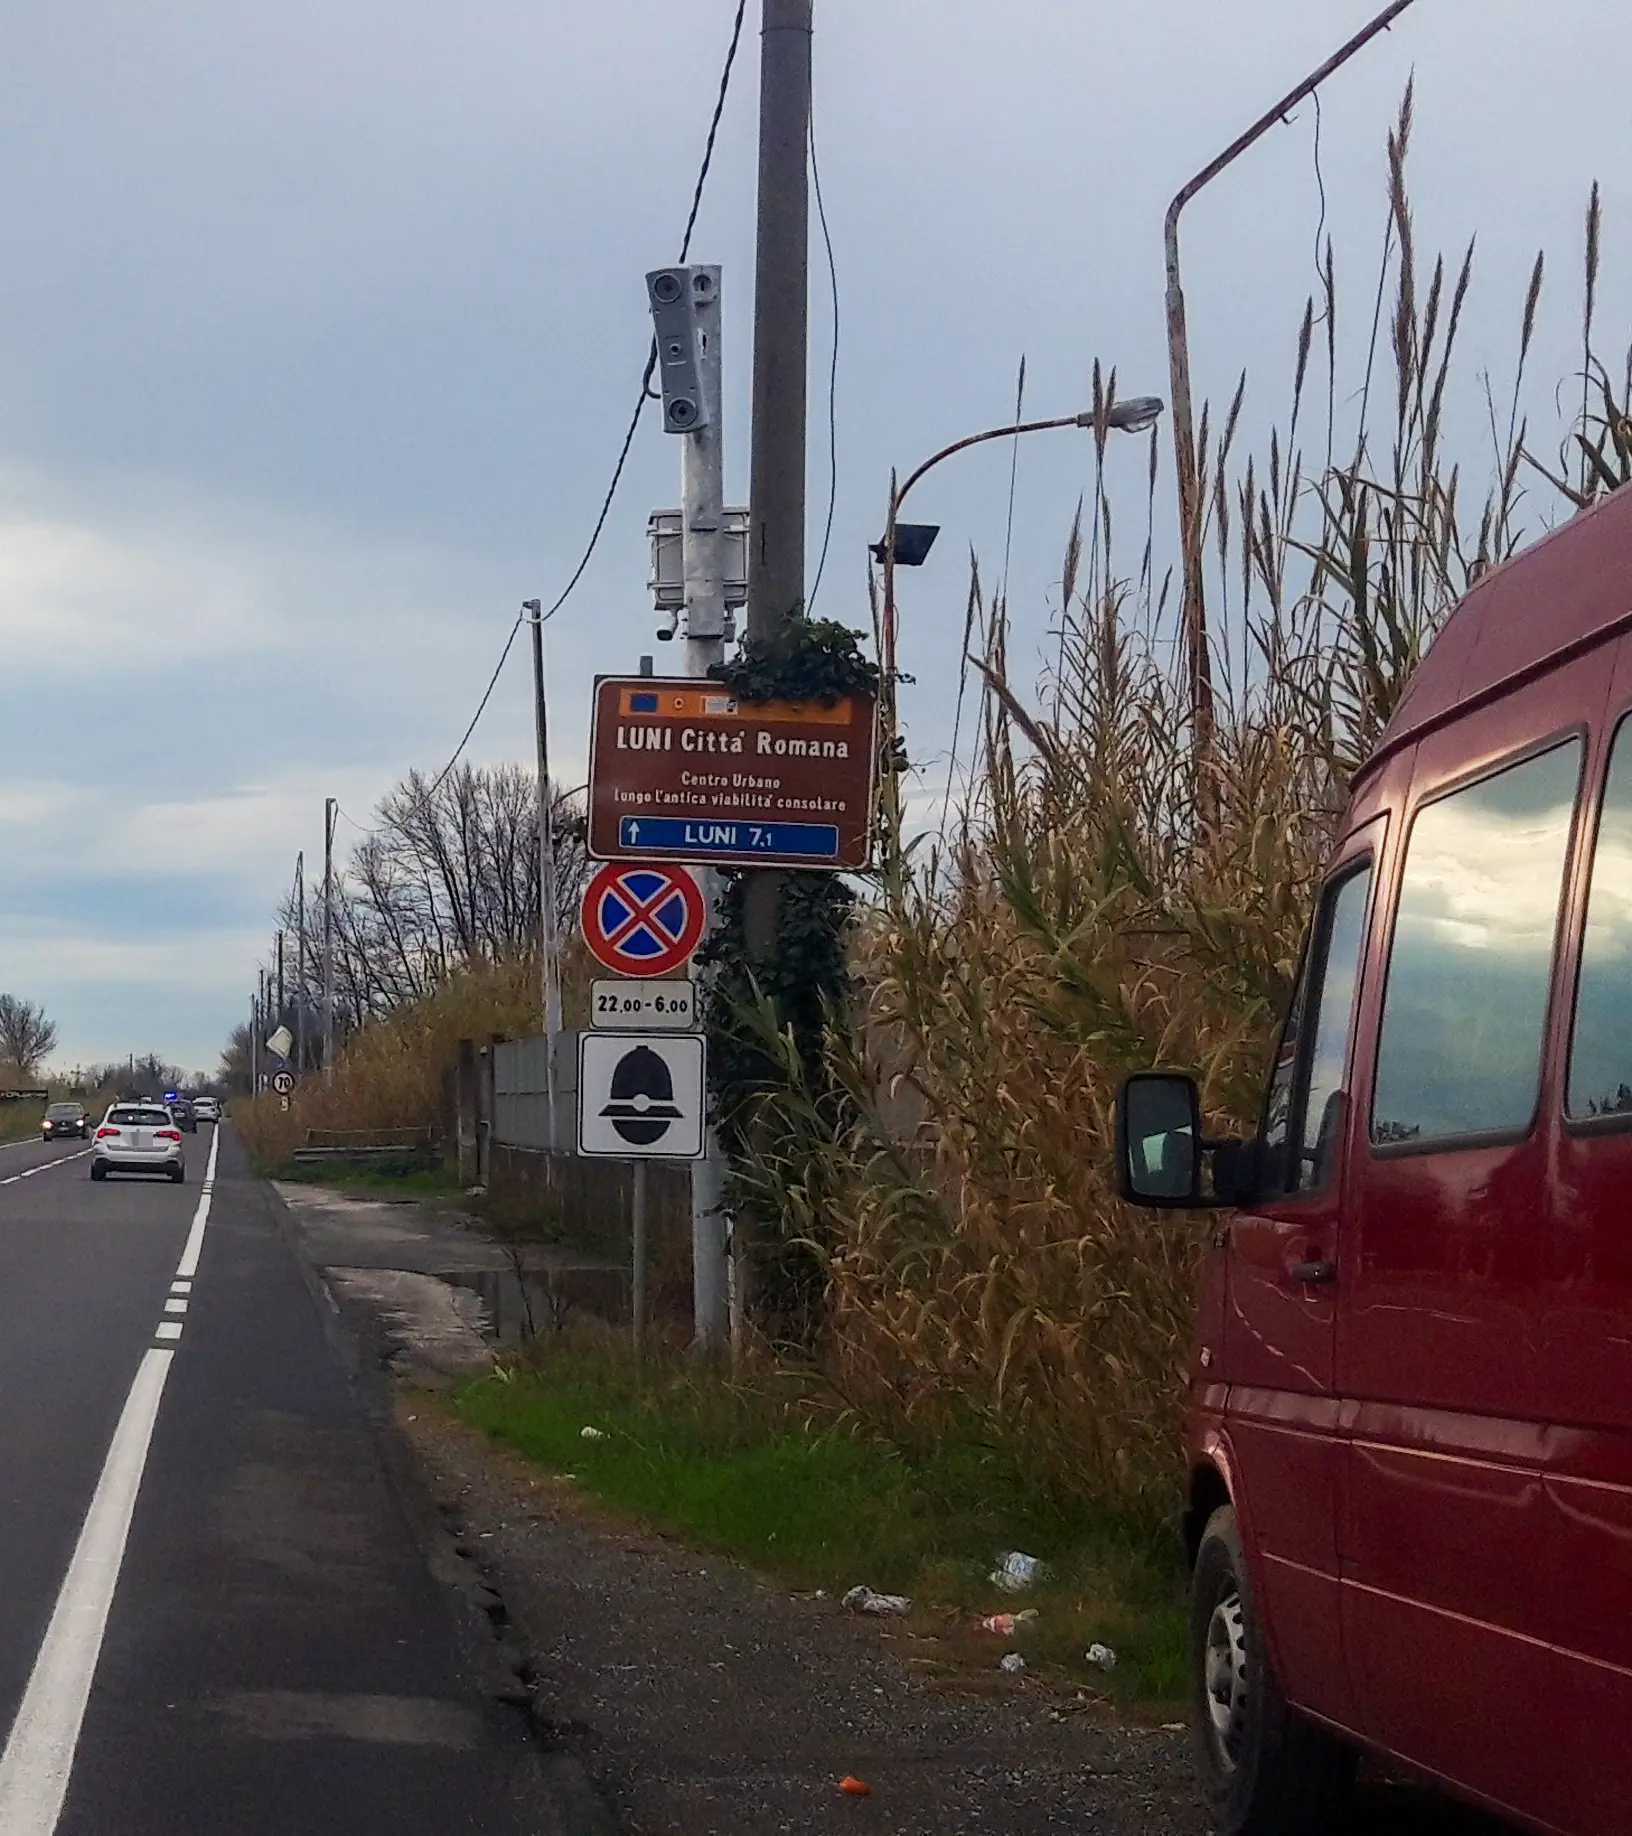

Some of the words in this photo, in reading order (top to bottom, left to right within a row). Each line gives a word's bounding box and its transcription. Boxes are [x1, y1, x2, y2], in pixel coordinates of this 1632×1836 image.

[617, 726, 671, 751] LUNI
[756, 731, 849, 759] Romana
[681, 771, 728, 787] Centro
[733, 773, 781, 790] Urbano
[777, 796, 846, 812] consolare
[684, 824, 737, 846] LUNI
[748, 828, 772, 848] 7.1
[279, 1076, 291, 1089] 70
